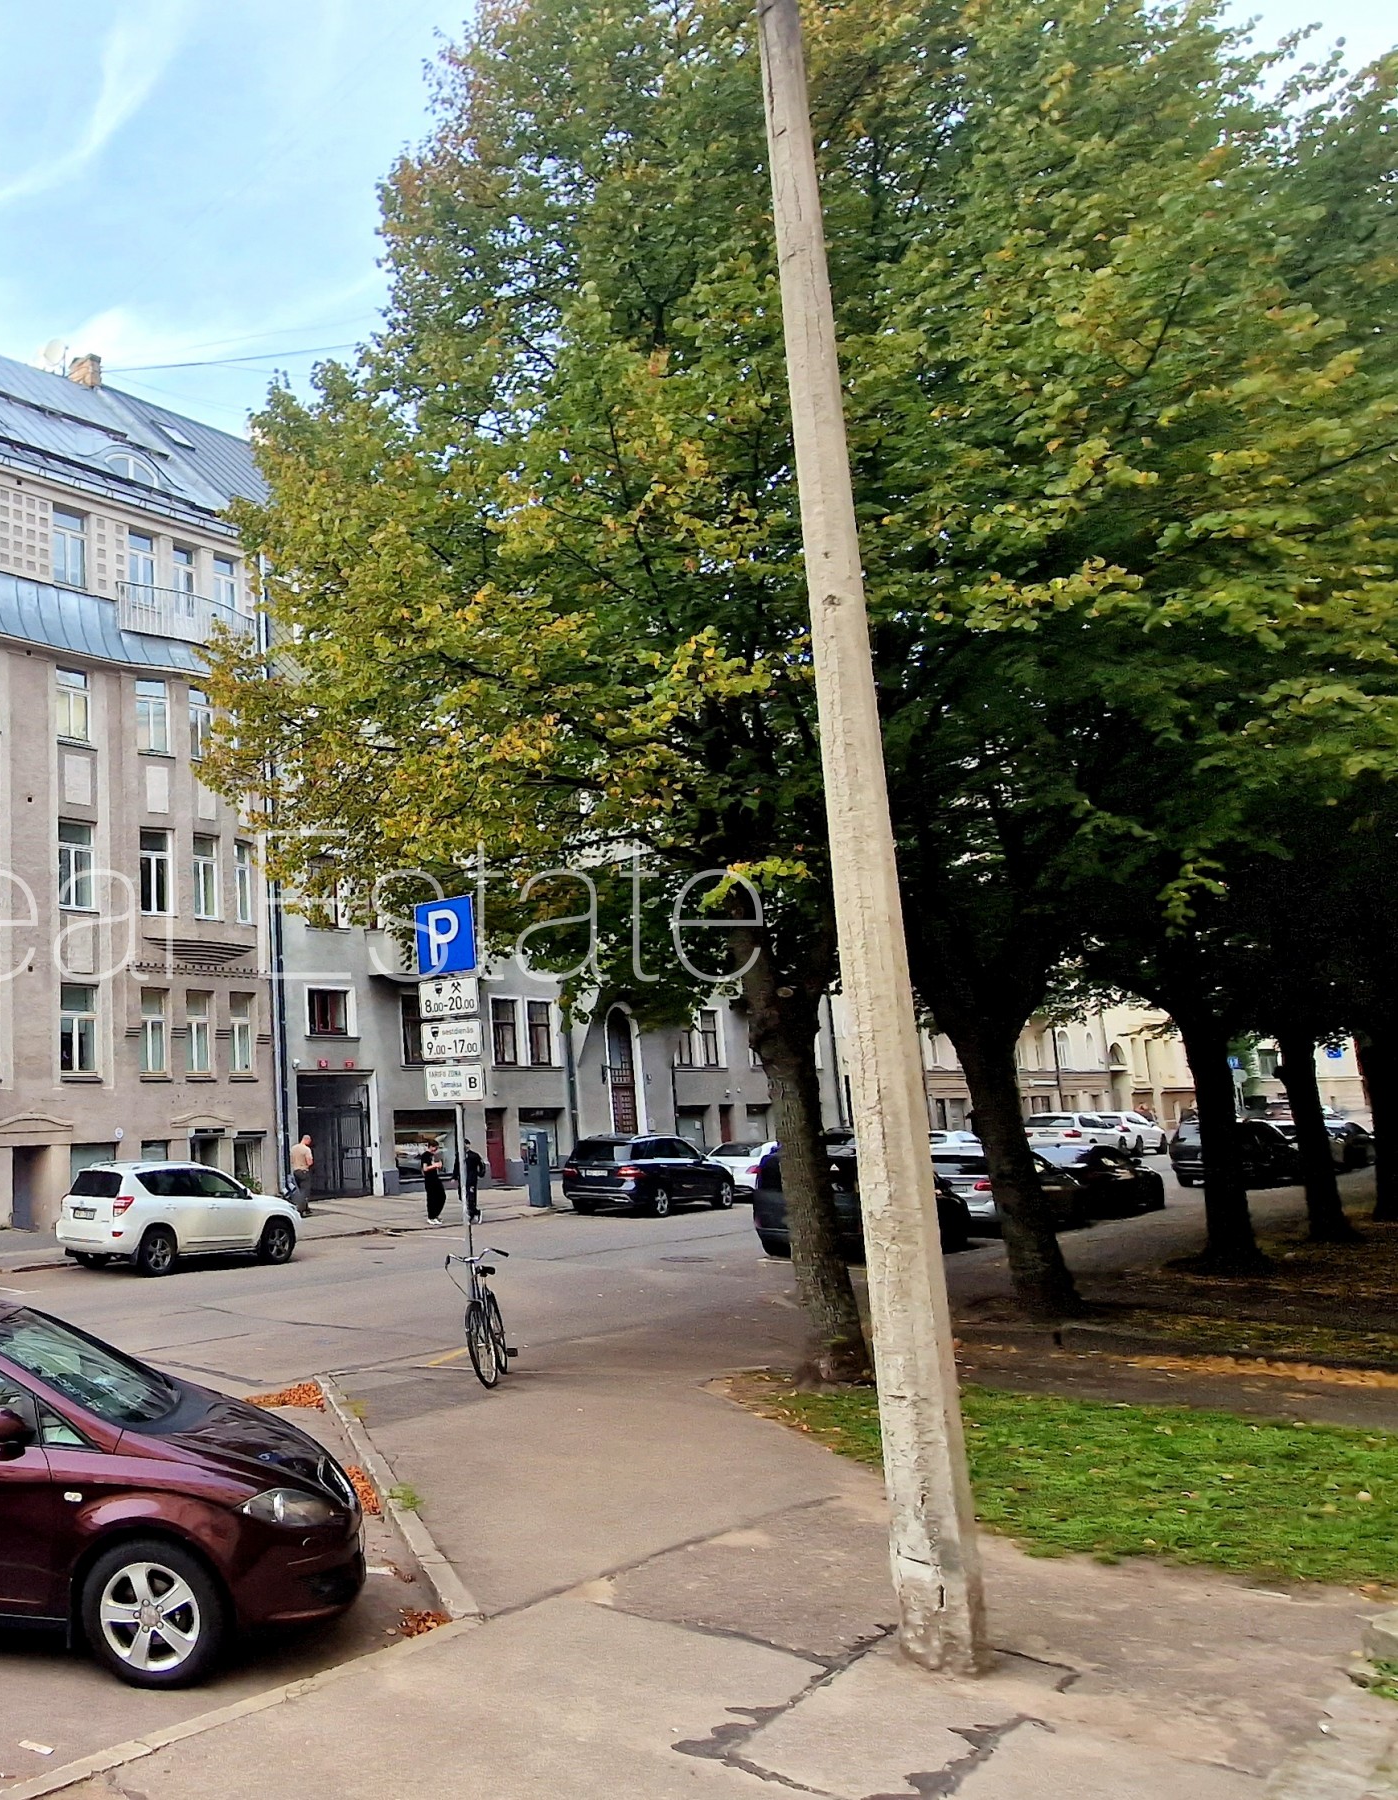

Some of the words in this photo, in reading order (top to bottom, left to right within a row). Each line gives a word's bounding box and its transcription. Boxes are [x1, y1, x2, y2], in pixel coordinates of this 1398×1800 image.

[427, 908, 459, 966] P
[424, 995, 475, 1014] 8.00-20.00
[468, 1076, 478, 1089] B
